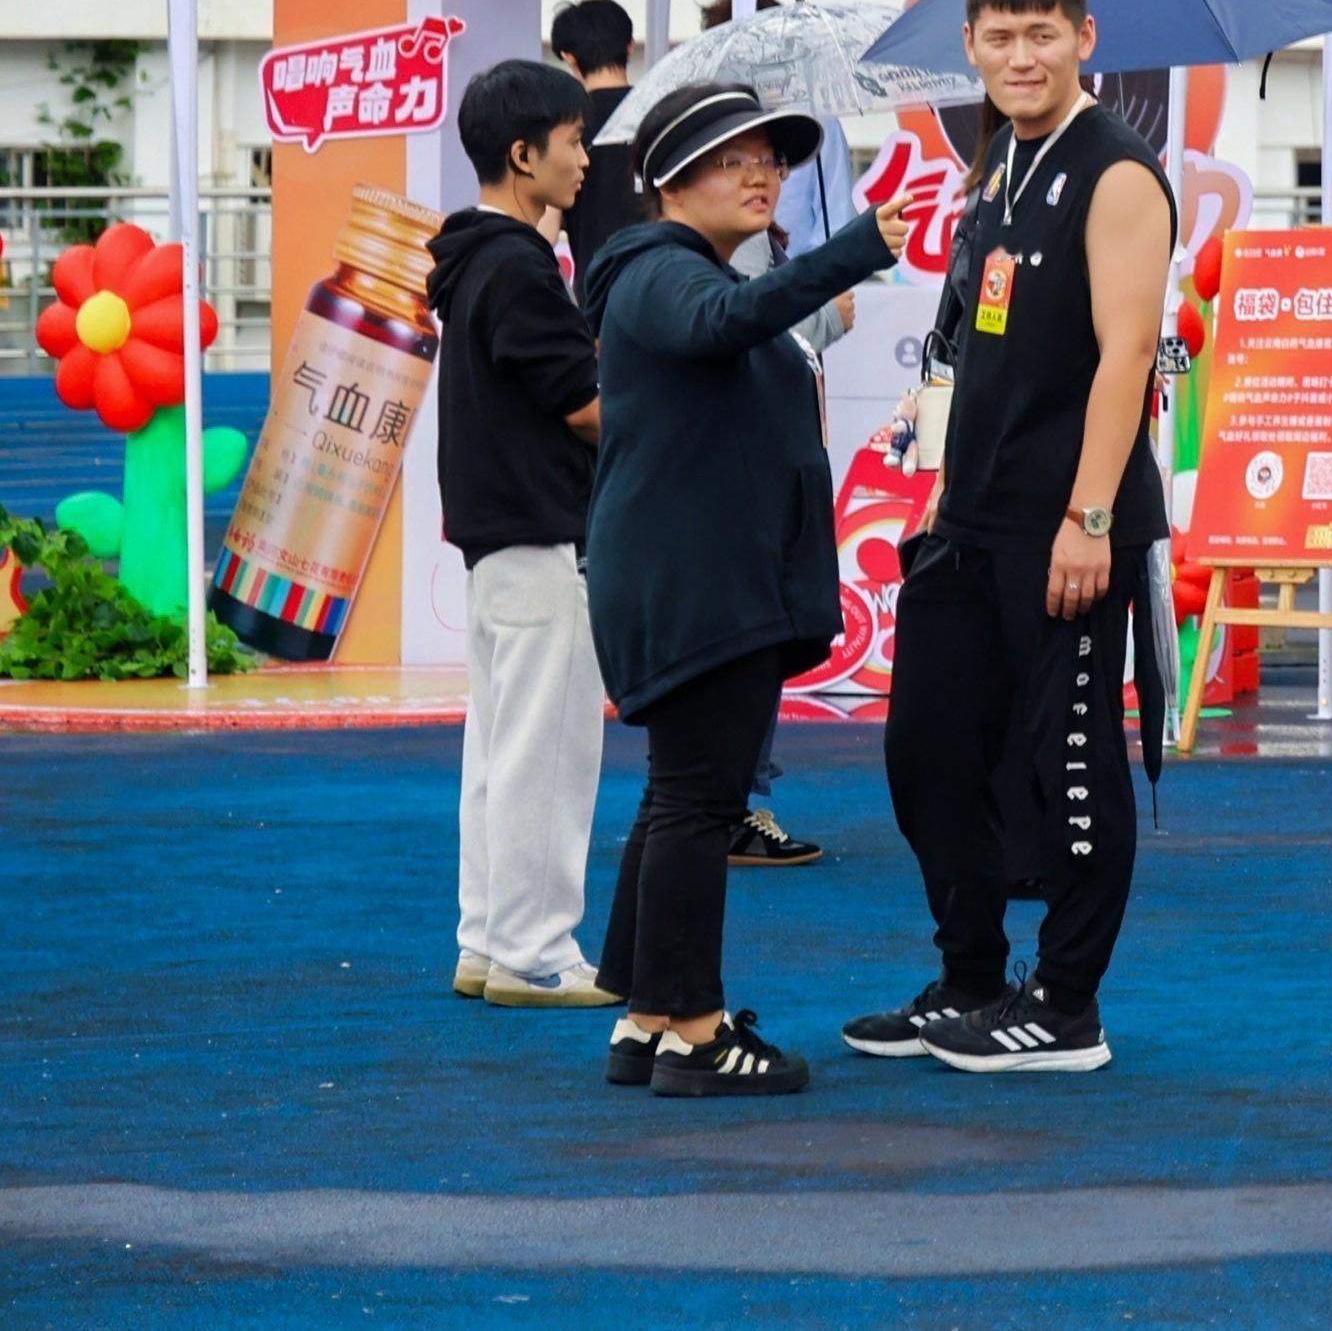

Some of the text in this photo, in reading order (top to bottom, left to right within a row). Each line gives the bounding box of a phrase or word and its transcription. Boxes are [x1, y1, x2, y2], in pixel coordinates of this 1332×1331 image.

[272, 36, 397, 94] 唱响气血
[322, 74, 438, 133] 声命力
[293, 360, 411, 447] 气血康
